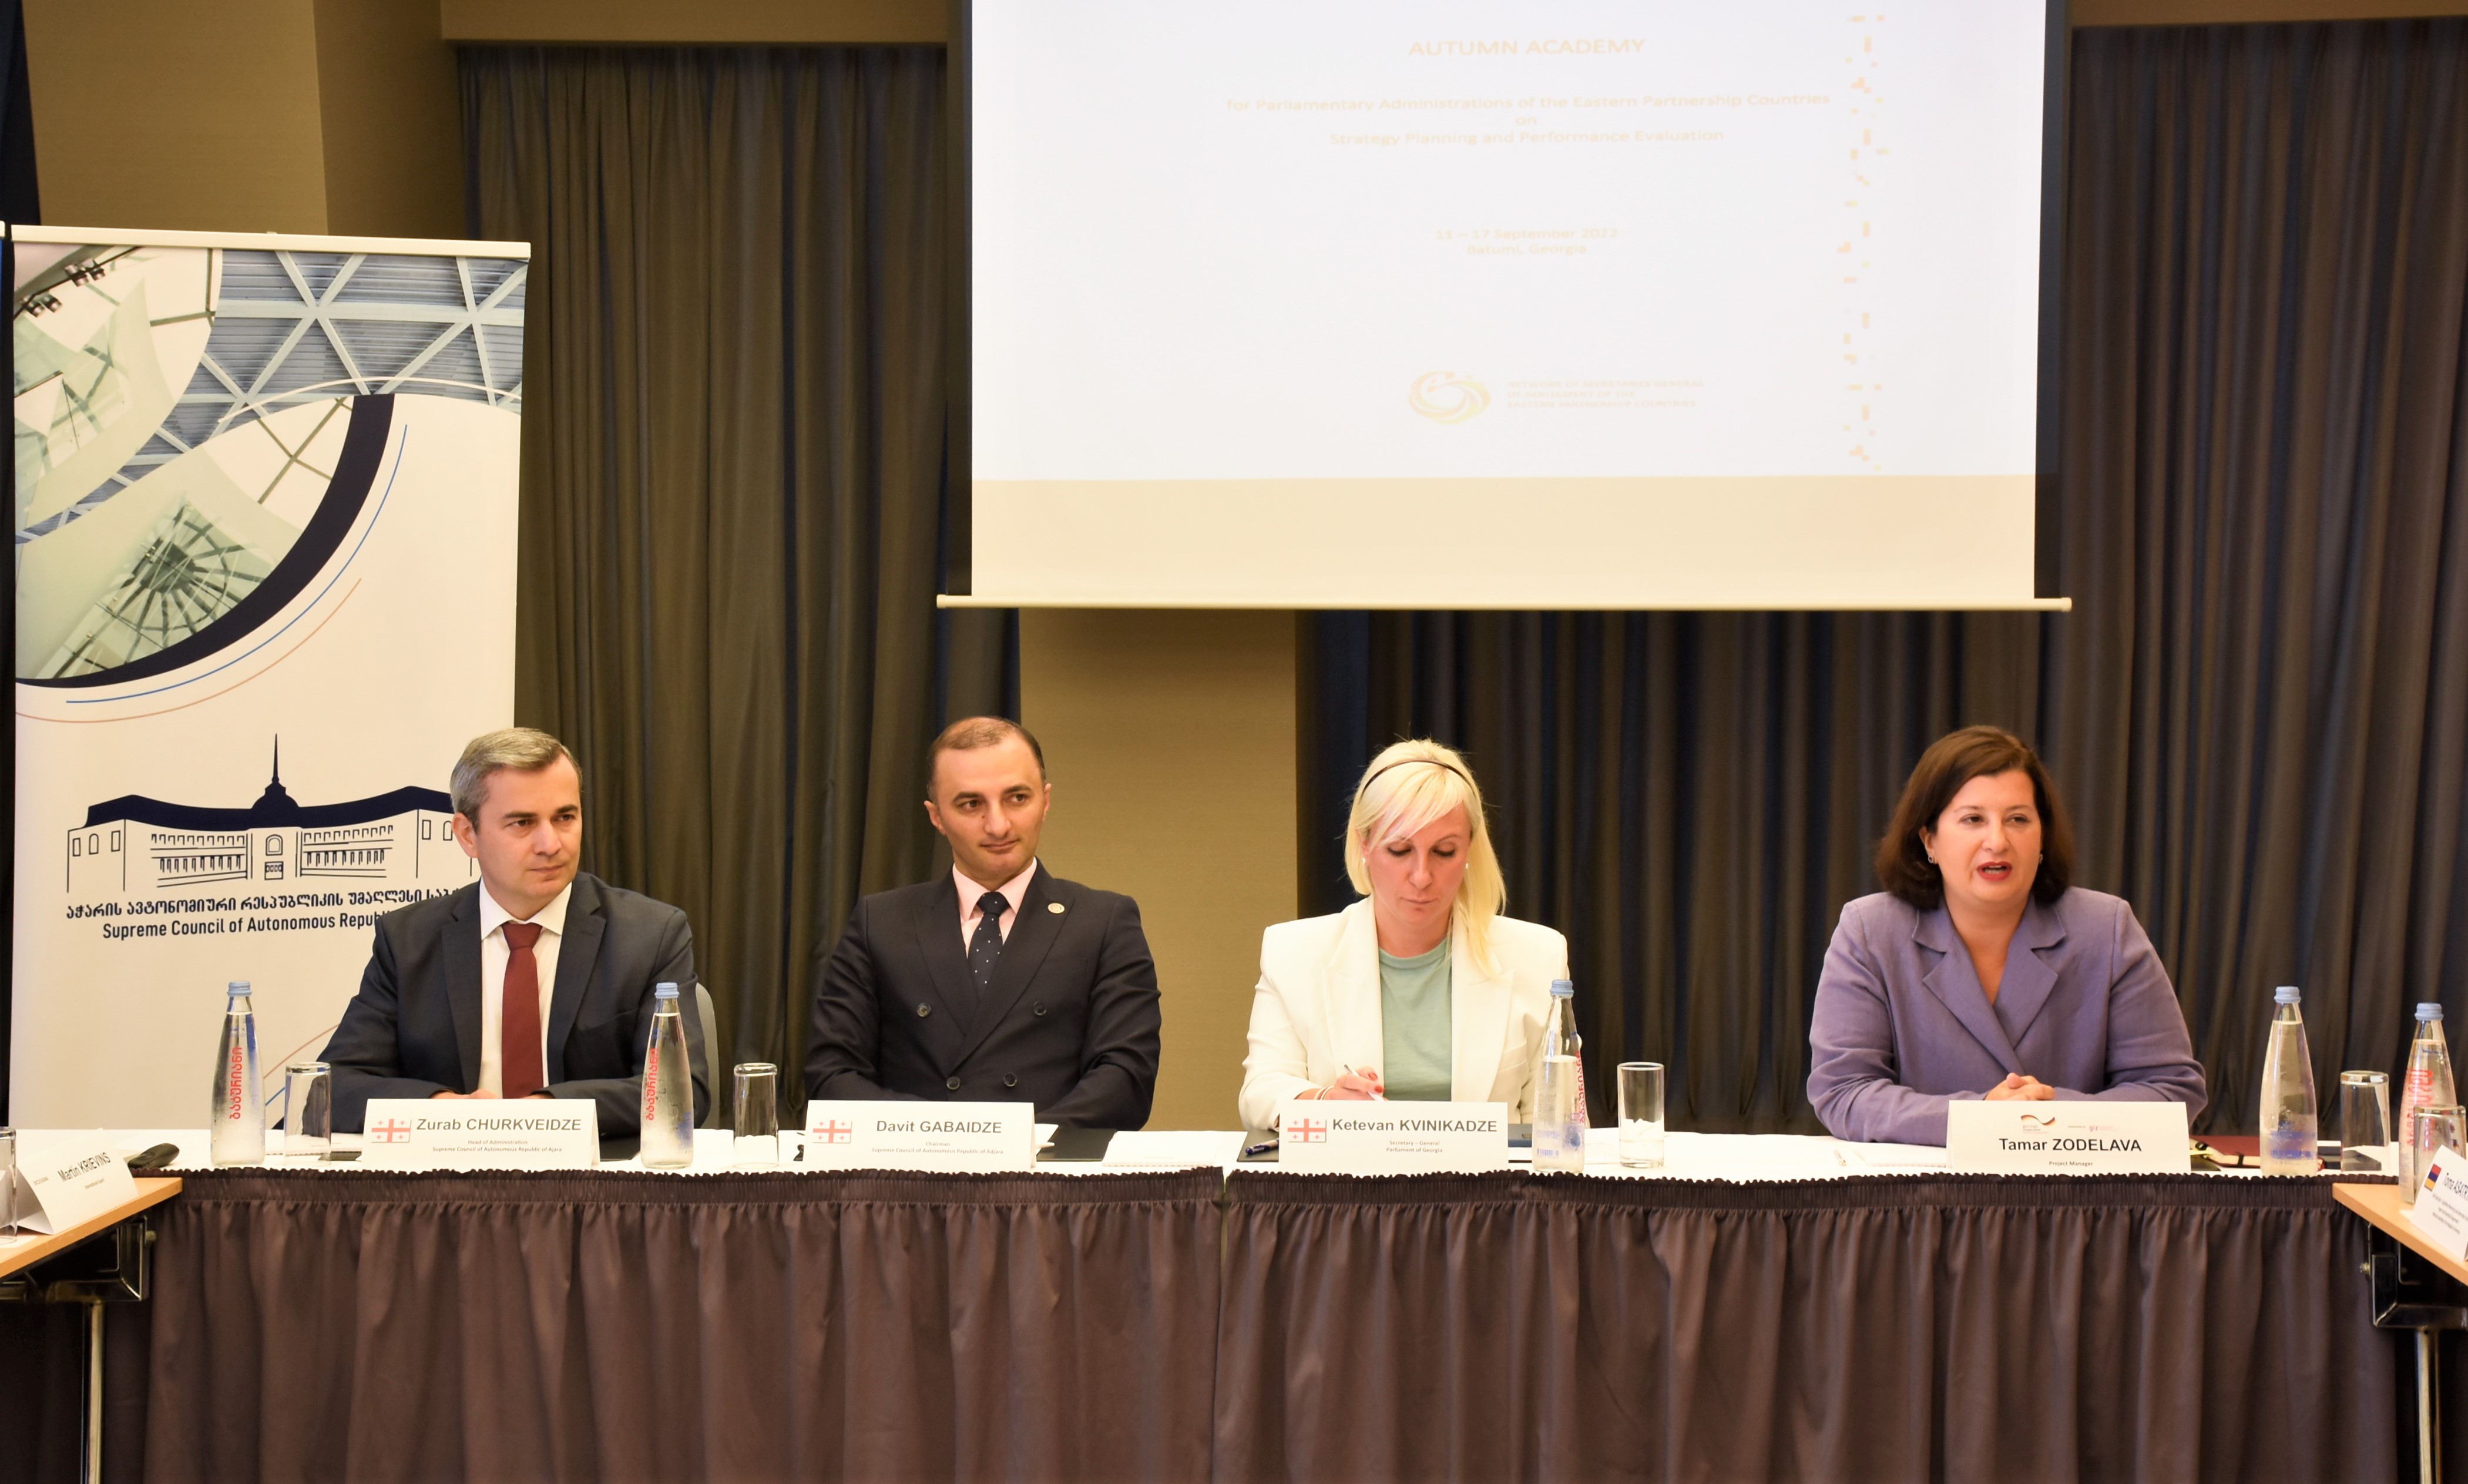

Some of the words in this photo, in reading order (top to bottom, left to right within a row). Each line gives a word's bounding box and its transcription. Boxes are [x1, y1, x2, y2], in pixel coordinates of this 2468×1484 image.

[1409, 39, 1518, 56] AUTUMN
[1525, 38, 1646, 55] ACADEMY
[1226, 99, 1251, 112] for
[1256, 99, 1375, 112] Parliamentary
[1379, 98, 1514, 110] Administrations
[1517, 96, 1536, 108] of
[1539, 97, 1569, 108] the
[1573, 96, 1639, 108] Eastern
[1643, 95, 1743, 108] Partnership
[1747, 93, 1831, 106] Countries
[1515, 116, 1538, 126] on
[1330, 133, 1401, 147] Strategy
[1405, 132, 1479, 146] Planning
[1482, 131, 1515, 144] and
[1519, 130, 1630, 143] Performance
[1634, 129, 1725, 142] Evaluation
[1436, 230, 1453, 240] 11
[1472, 230, 1490, 239] 17
[1495, 229, 1576, 240] September
[1581, 229, 1618, 239] 2022
[1467, 244, 1524, 255] Batumi,
[1528, 243, 1588, 256] Georgia
[66, 902, 122, 919] აჭარის
[127, 897, 236, 915] ავტონომიური
[240, 892, 344, 910] რესპუბლიკის
[348, 889, 422, 905] უმაღლესი
[103, 923, 167, 941] Supreme
[172, 918, 225, 935] Council
[229, 917, 243, 933] of
[247, 915, 336, 932] Autonomous
[230, 1046, 243, 1119] ბაკურიანი
[416, 1119, 461, 1130] Zurab
[466, 1118, 582, 1130] CHURKVEIDZE
[877, 1120, 915, 1132] Davit
[919, 1121, 1002, 1133] GABAIDZE
[1332, 1119, 1394, 1131] Ketevan
[1399, 1119, 1497, 1132] KVINIKADZE
[1999, 1138, 2047, 1151] Tamar
[2052, 1139, 2142, 1151] ZODELAVA
[58, 1166, 81, 1182] Martin
[78, 1151, 110, 1174] KRIEVINS
